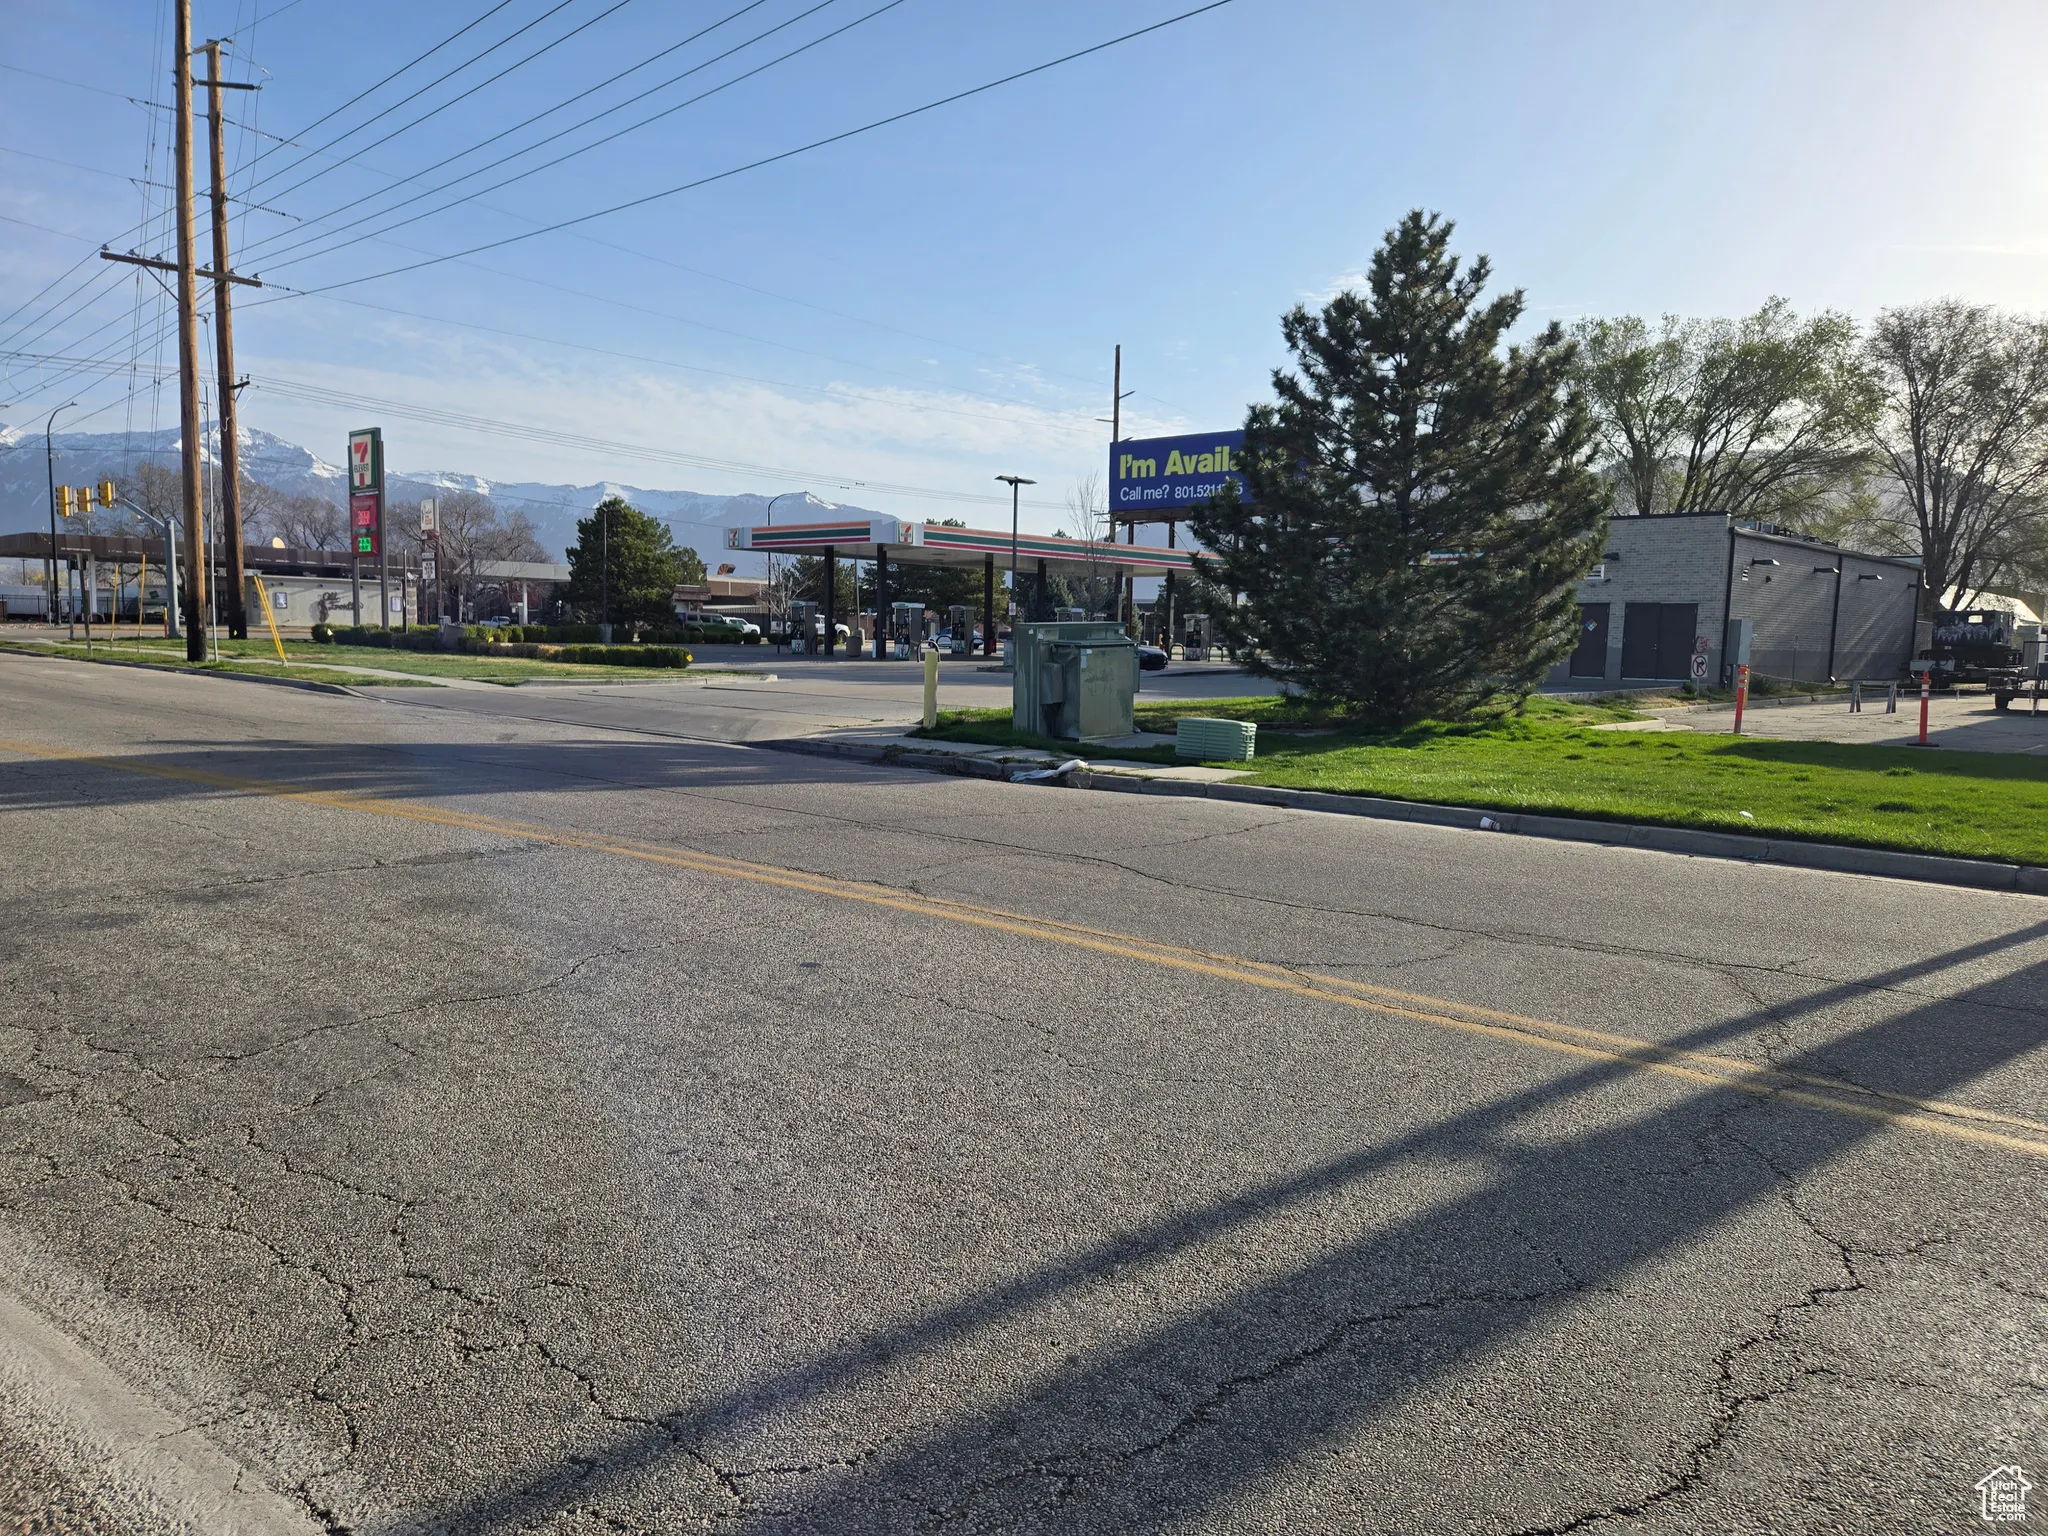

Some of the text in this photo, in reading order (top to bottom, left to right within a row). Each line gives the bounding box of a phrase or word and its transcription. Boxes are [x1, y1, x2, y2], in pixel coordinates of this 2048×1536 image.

[1119, 454, 1156, 479] I'm
[1120, 486, 1142, 501] Call
[1143, 484, 1170, 500] me?
